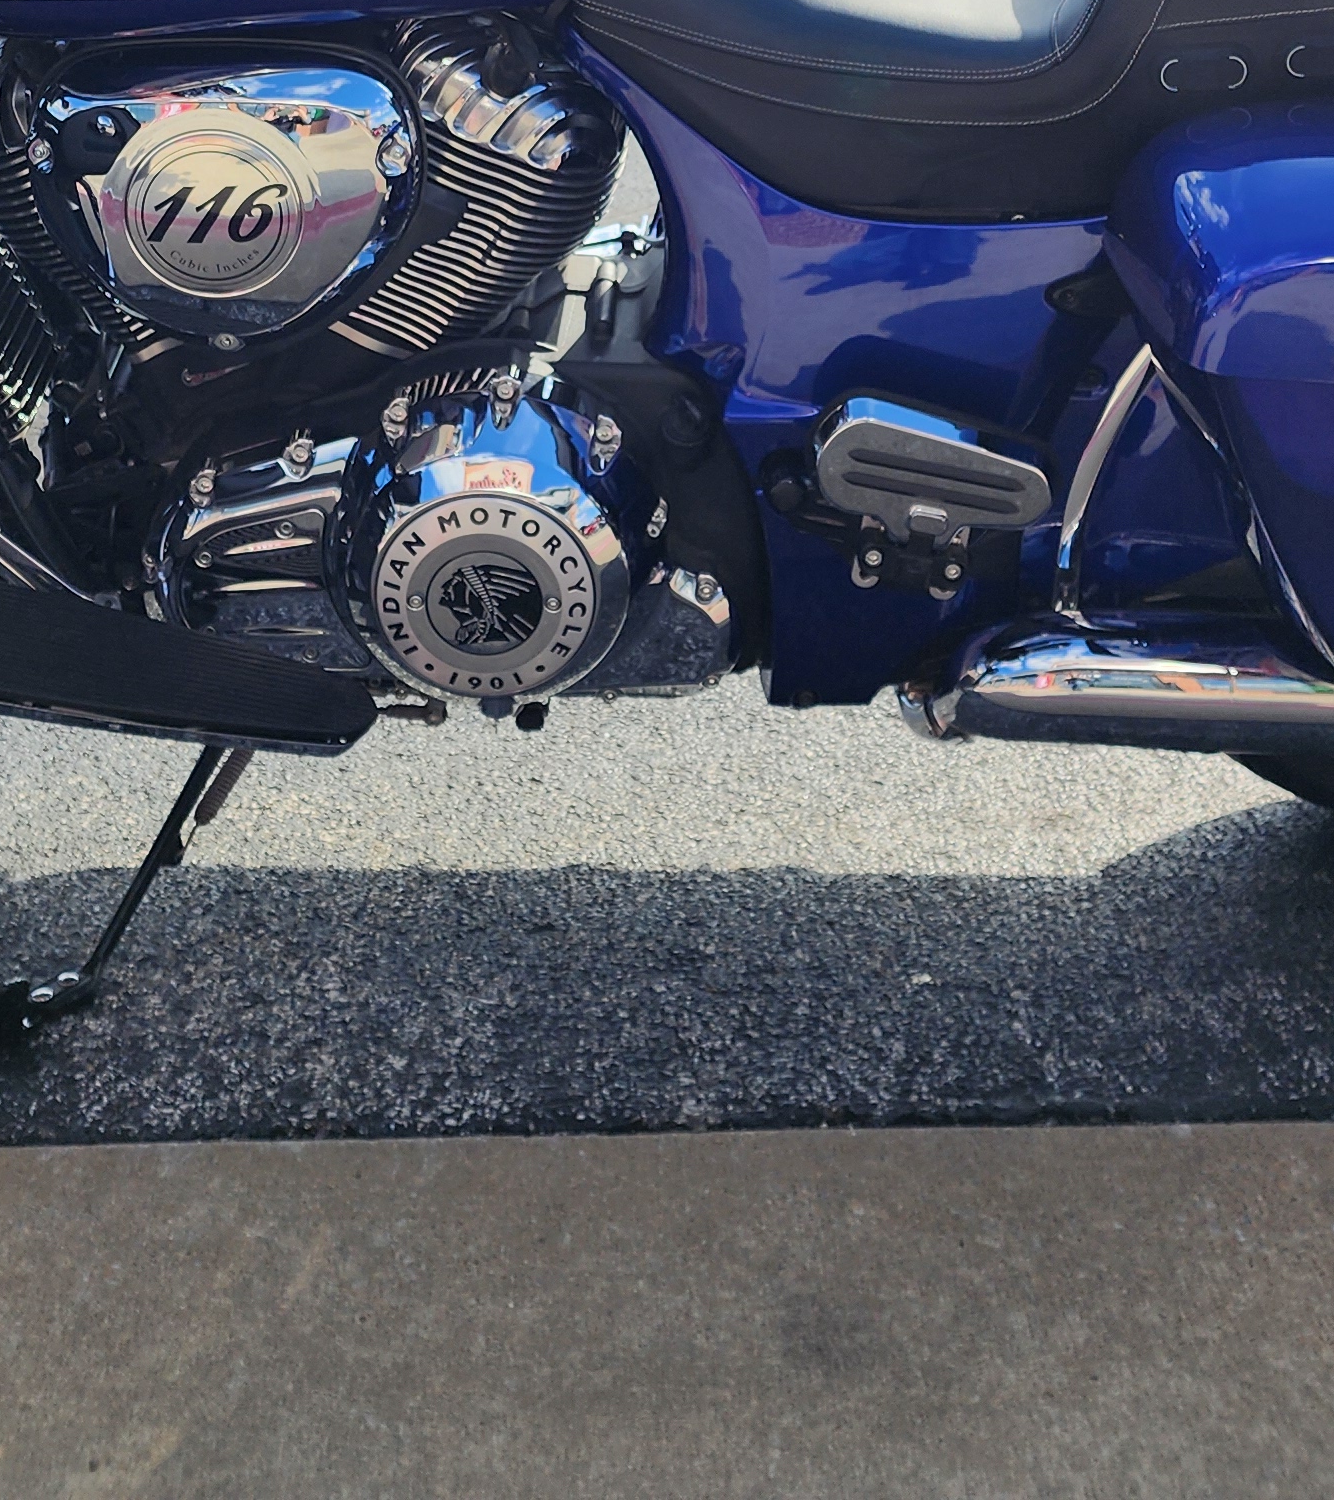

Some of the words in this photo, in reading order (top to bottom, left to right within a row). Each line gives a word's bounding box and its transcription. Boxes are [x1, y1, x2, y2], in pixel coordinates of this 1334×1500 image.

[146, 183, 288, 243] 116
[170, 250, 209, 273] Cubic
[216, 249, 260, 274] Inches
[382, 531, 426, 656] INDIAN
[437, 507, 587, 658] MOTORCYCLE
[449, 671, 524, 690] 1901
